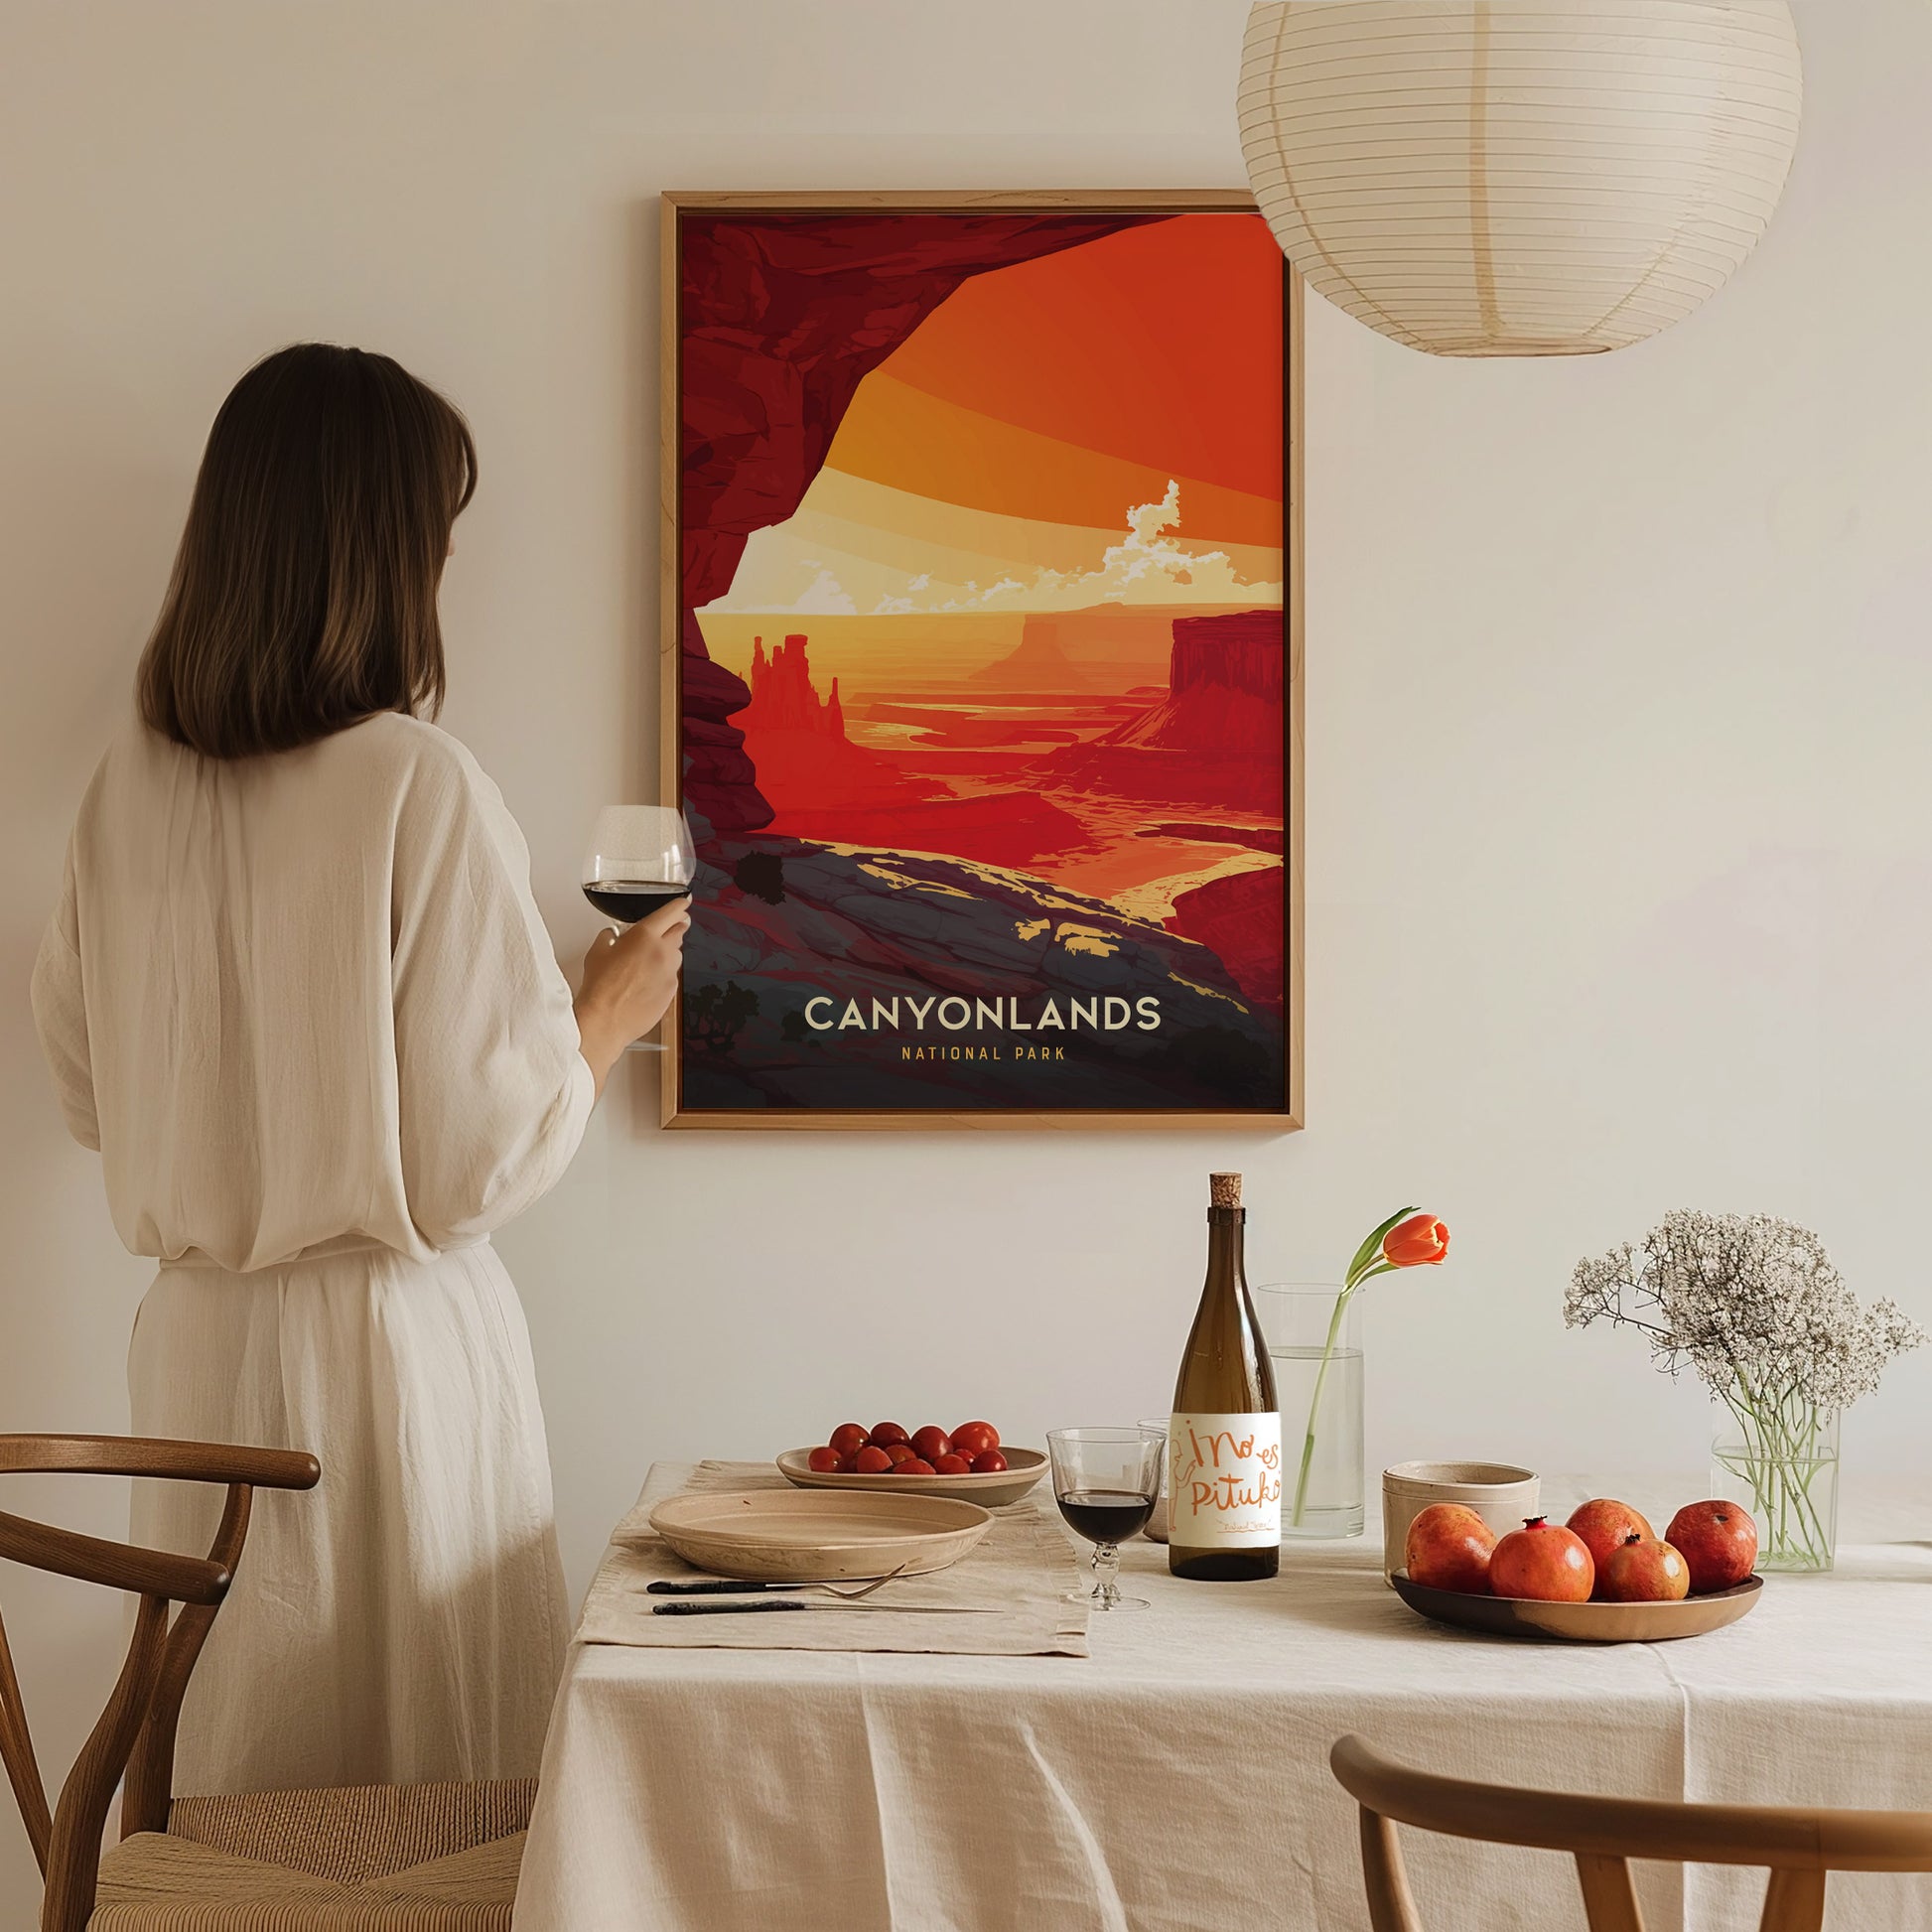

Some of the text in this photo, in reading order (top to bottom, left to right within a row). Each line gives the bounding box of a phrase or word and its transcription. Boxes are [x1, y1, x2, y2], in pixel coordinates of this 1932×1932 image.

[804, 996, 1162, 1031] CANYONLANDS
[901, 1046, 1064, 1060] NATIONAL PARK
[1256, 1444, 1279, 1469] es
